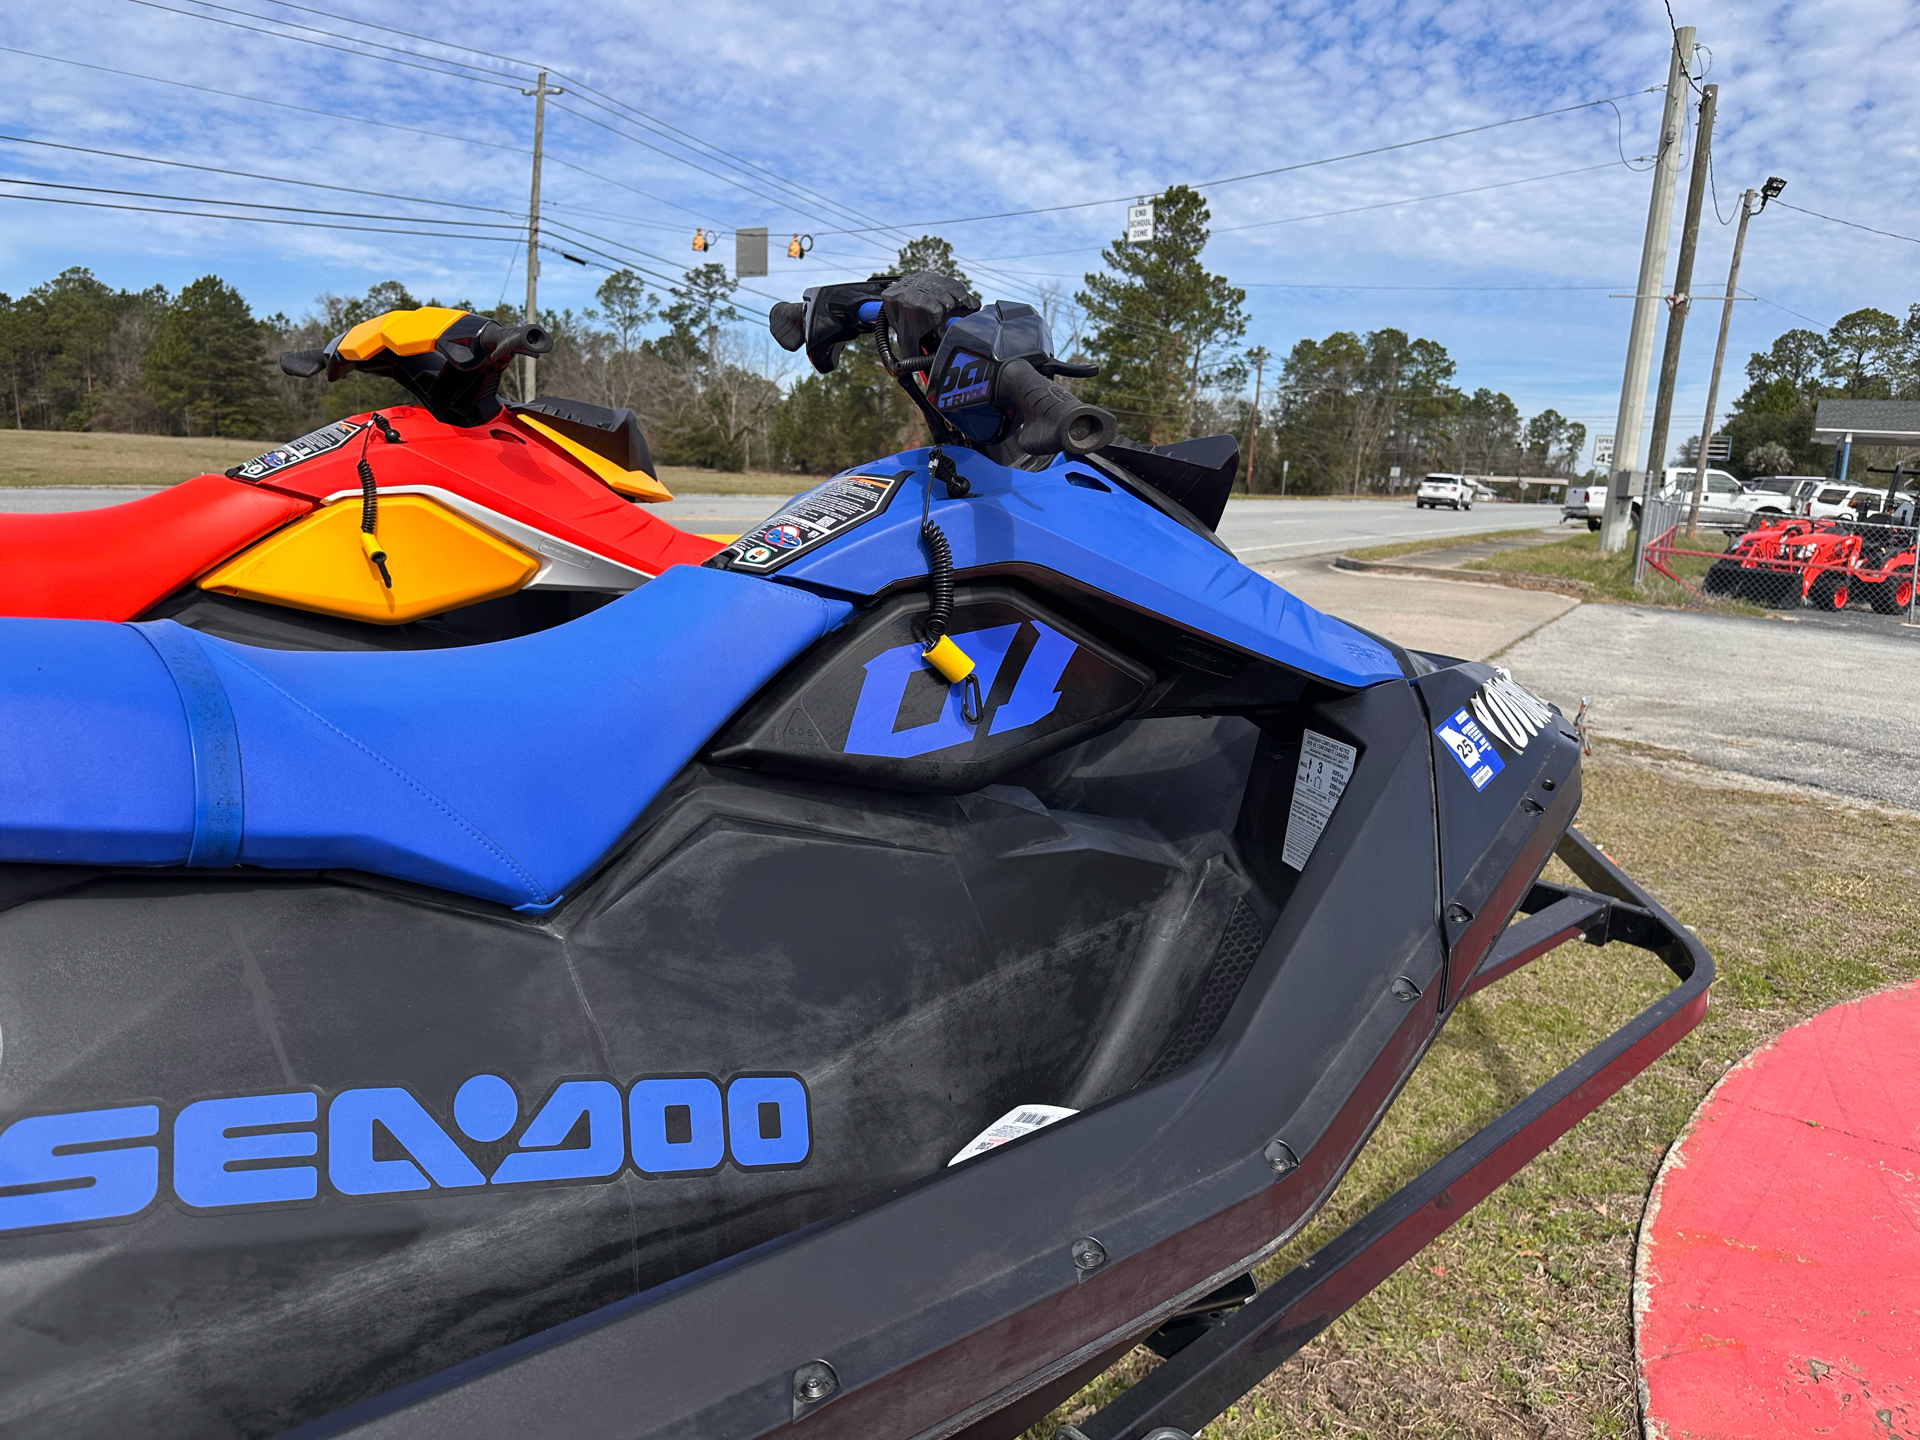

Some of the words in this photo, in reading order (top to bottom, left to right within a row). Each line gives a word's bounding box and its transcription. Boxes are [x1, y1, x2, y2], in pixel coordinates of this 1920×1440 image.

[1135, 209, 1147, 217] END
[1130, 219, 1152, 228] SCHOOL
[1457, 739, 1473, 759] 25
[1317, 762, 1323, 774] 3
